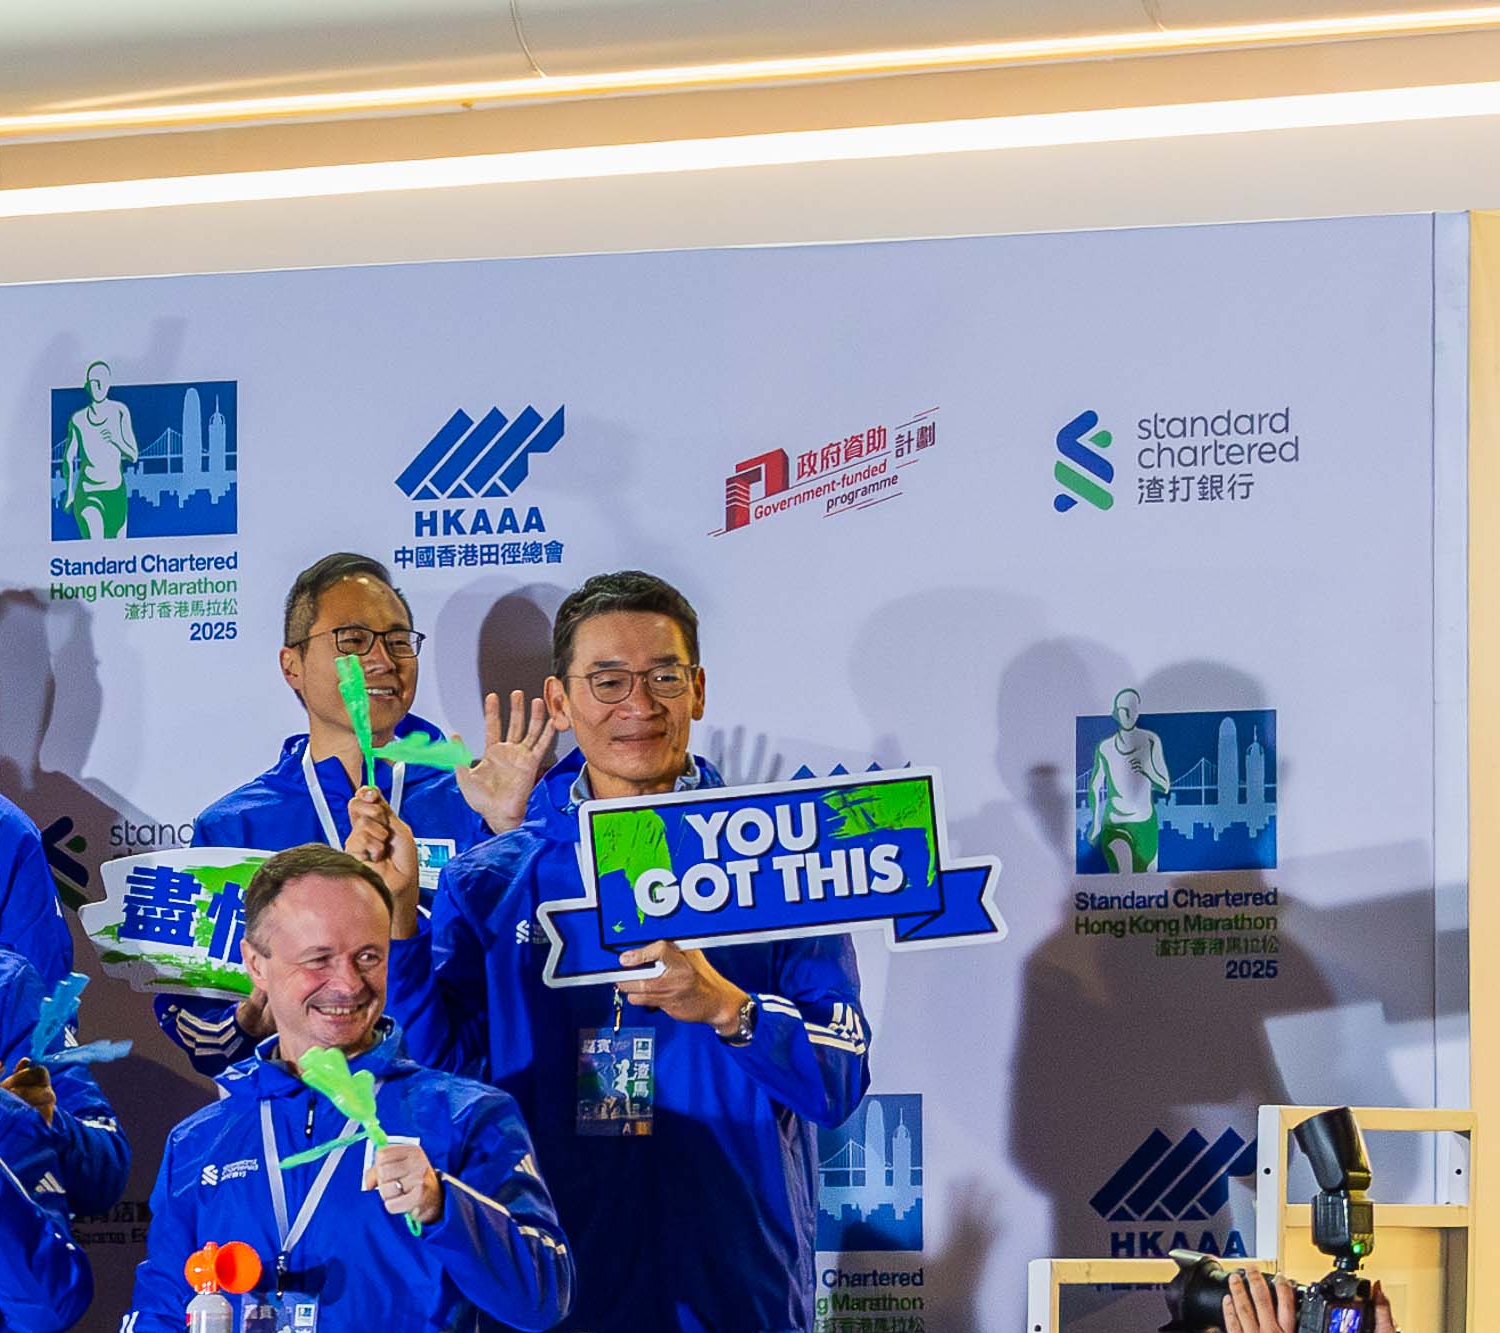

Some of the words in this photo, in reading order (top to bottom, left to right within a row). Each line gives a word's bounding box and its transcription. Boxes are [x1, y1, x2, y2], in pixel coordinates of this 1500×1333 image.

[1137, 406, 1290, 440] standard
[797, 424, 888, 481] 政府資助
[895, 421, 936, 458] 計劃
[1137, 435, 1300, 470] chartered
[753, 459, 888, 521] Government-funded
[824, 474, 900, 513] programme
[1137, 473, 1254, 505] 渣打銀行
[414, 506, 547, 538] HKAAA
[50, 555, 137, 577] Standard
[141, 552, 238, 574] Chartered
[393, 540, 565, 570] 中國香港田徑總會
[50, 581, 97, 602] Hong
[101, 579, 147, 600] Kong
[151, 577, 238, 597] Marathon
[124, 598, 238, 620] 渣打香港馬拉松
[189, 621, 238, 641] 2025
[684, 801, 819, 861] YOU
[633, 858, 759, 918] GOT
[771, 843, 906, 904] THIS
[1075, 888, 1169, 911] Standard
[1172, 888, 1278, 908] Chartered
[1074, 916, 1125, 938] Hong
[1129, 915, 1180, 936] Kong
[1184, 913, 1278, 933] Marathon
[1225, 959, 1278, 980] 2025
[822, 1268, 925, 1289] Chartered
[831, 1290, 925, 1312] Marathon
